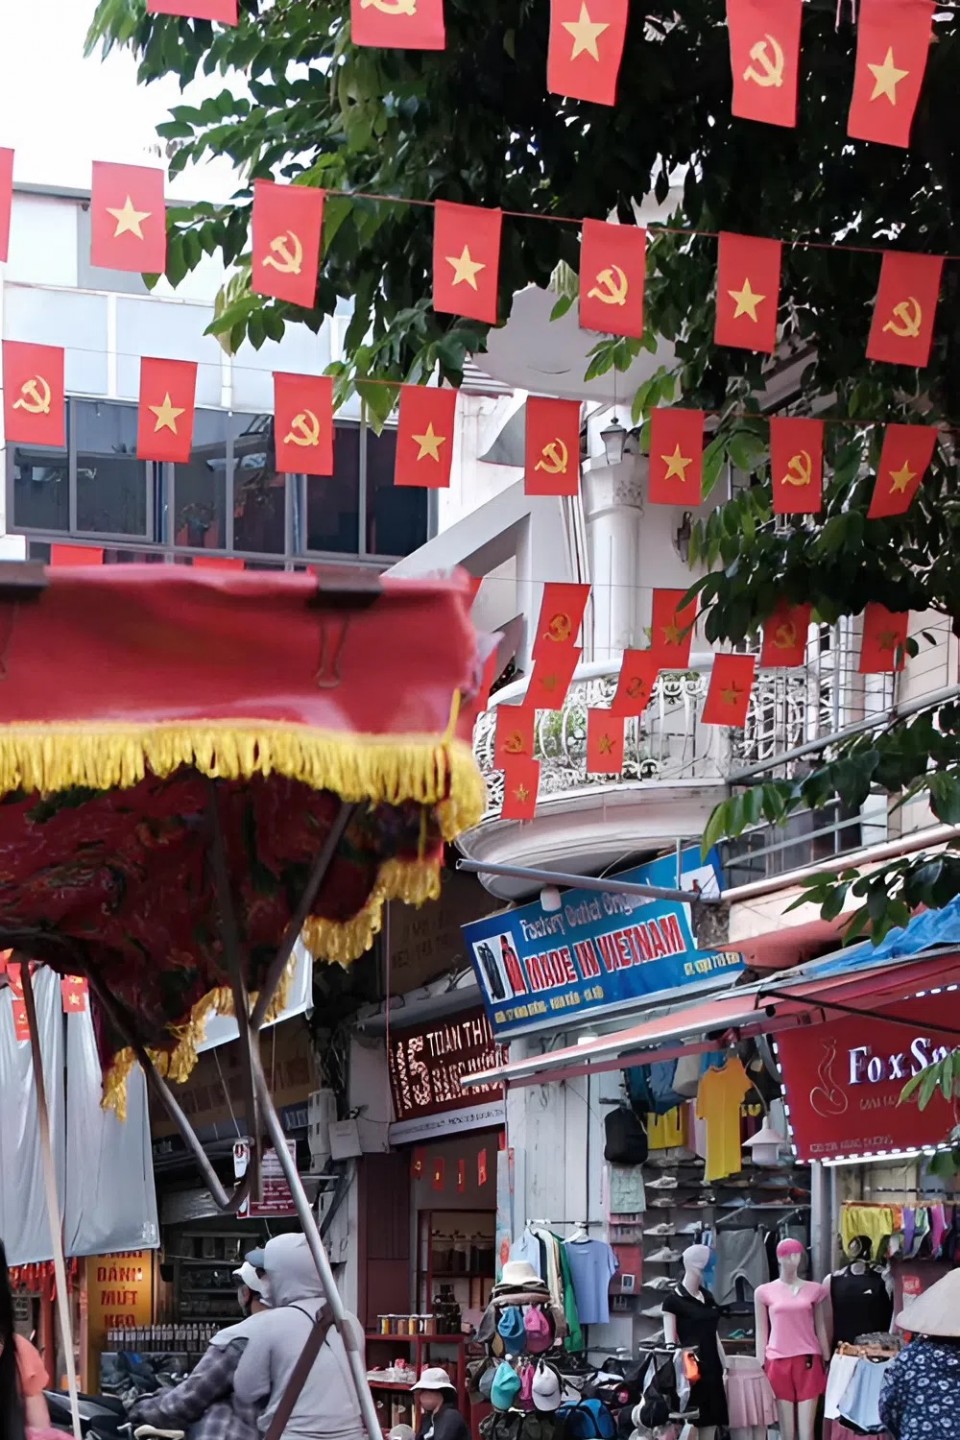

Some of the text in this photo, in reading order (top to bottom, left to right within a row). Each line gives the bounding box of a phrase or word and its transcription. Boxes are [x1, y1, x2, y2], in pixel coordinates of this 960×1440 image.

[523, 944, 578, 993] MADE
[572, 938, 601, 980] IN
[594, 912, 687, 974] VIETNAM
